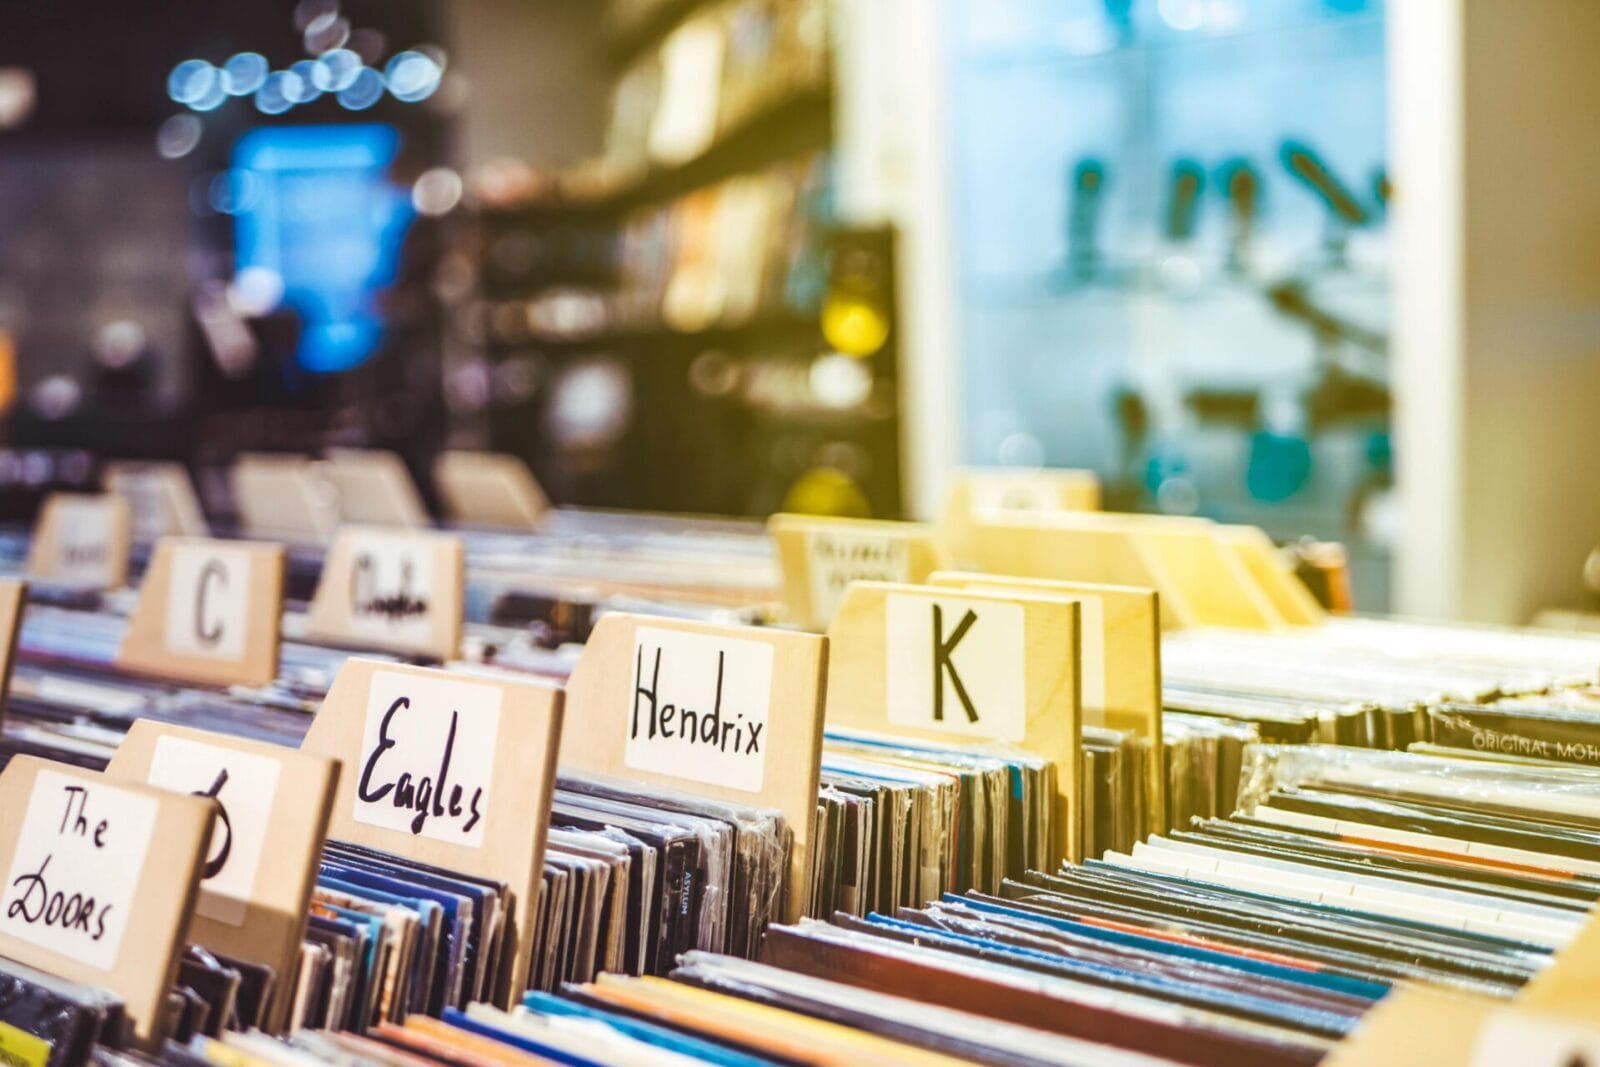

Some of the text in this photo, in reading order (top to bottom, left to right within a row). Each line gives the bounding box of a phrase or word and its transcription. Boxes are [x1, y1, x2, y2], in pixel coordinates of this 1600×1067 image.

[195, 560, 229, 648] C
[632, 643, 763, 755] Hendrix
[933, 602, 979, 723] K
[358, 696, 482, 835] Eagles
[1472, 732, 1549, 757] ORIGINAL
[60, 786, 108, 847] The
[681, 871, 692, 915] ASYLUM
